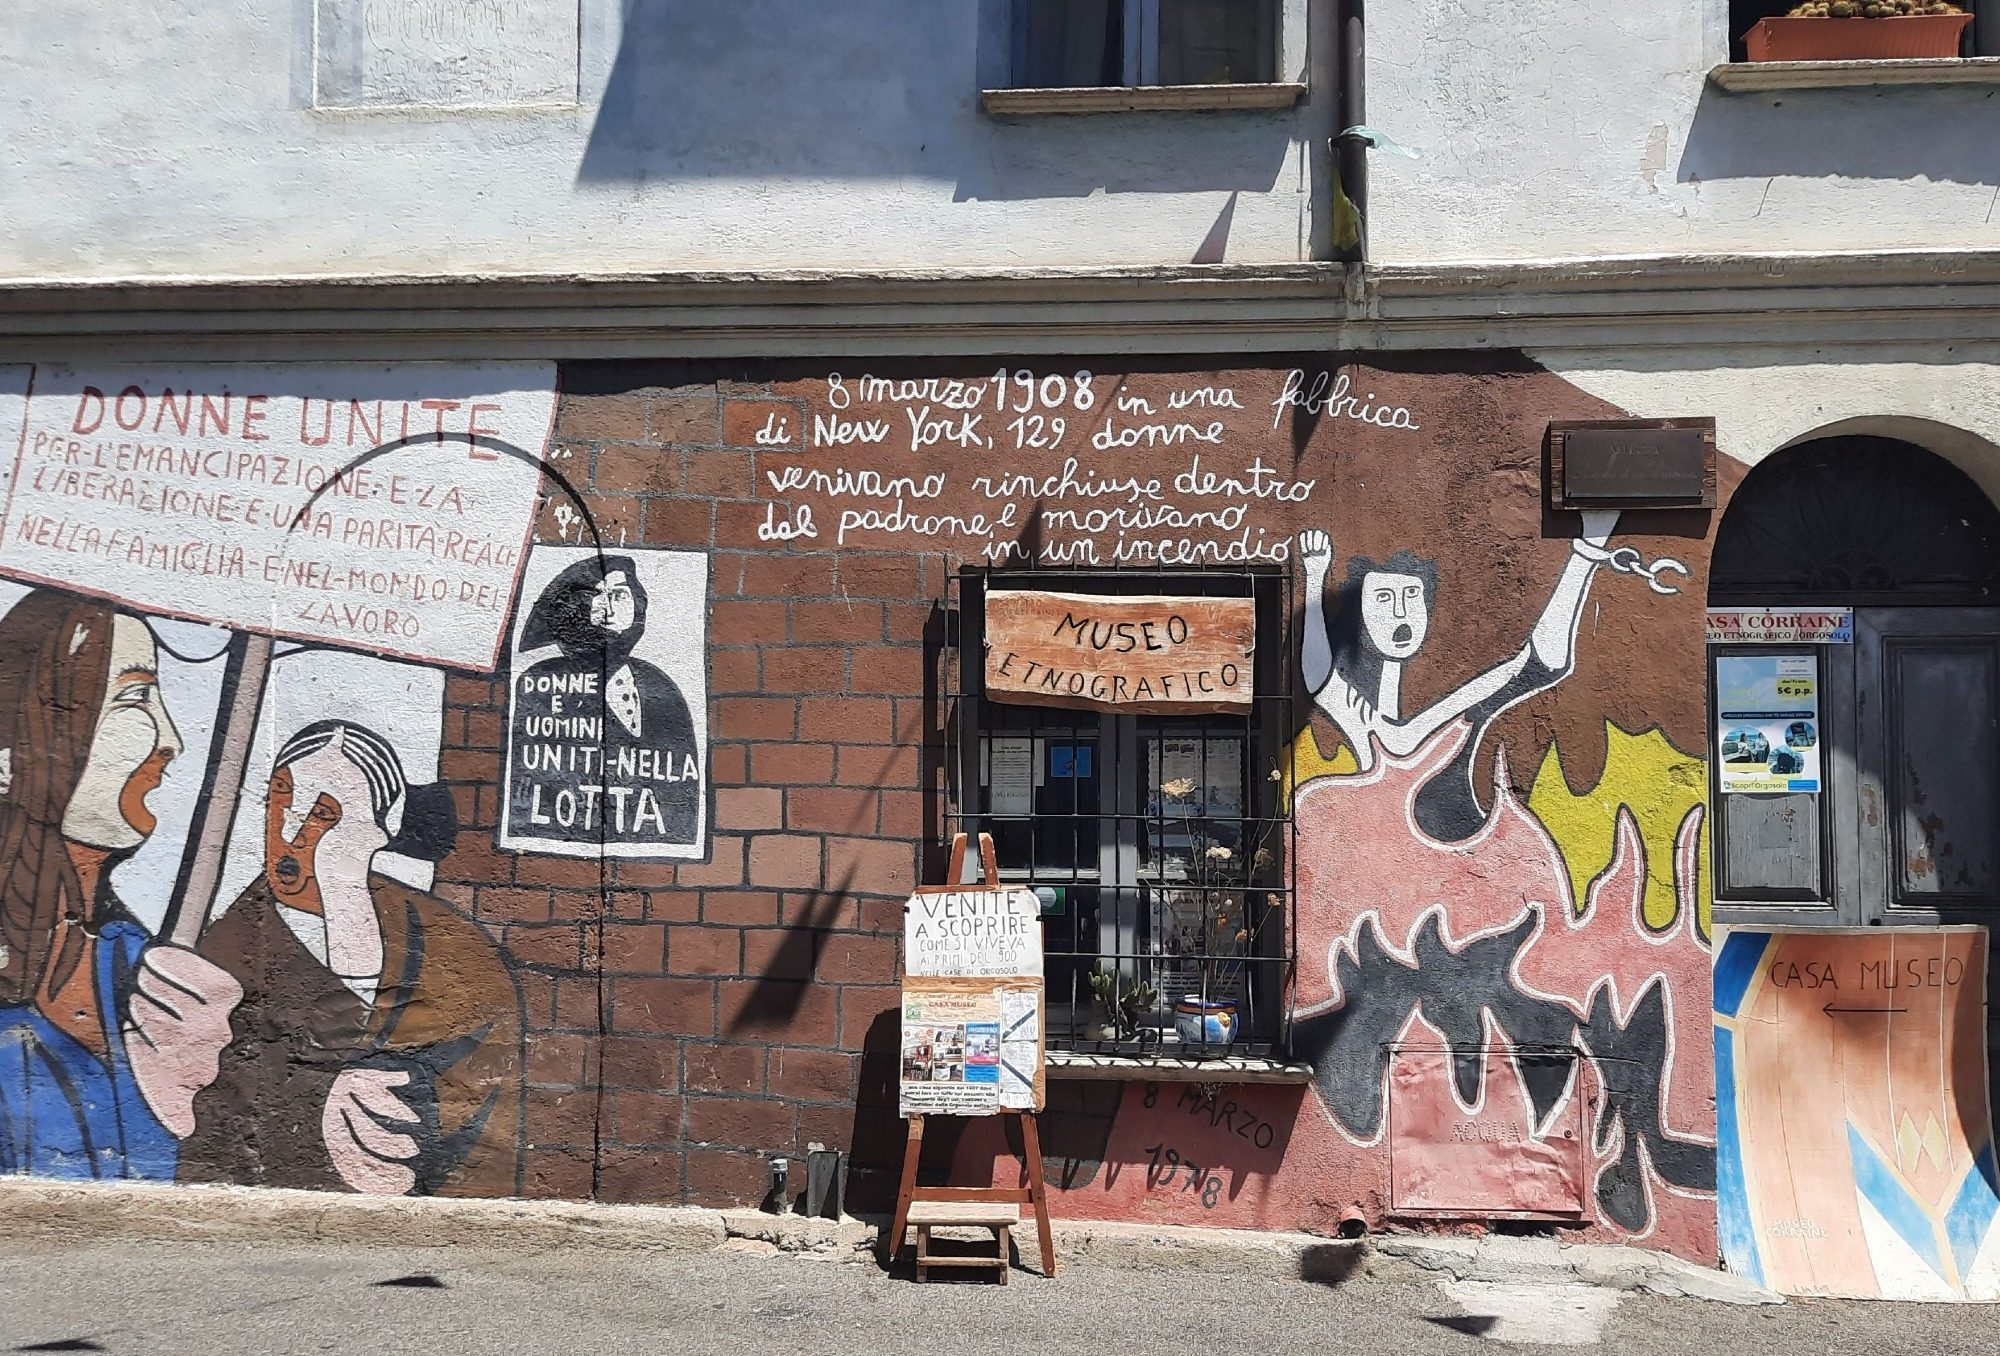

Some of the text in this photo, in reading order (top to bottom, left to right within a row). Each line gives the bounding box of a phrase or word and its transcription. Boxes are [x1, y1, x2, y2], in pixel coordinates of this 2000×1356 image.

[828, 367, 1420, 430] 8 marzo 1908 in una fabbrica
[72, 385, 502, 461] DONNE UNITE
[755, 413, 790, 445] di
[814, 413, 890, 447] New
[1006, 415, 1066, 450] 129
[1091, 418, 1224, 450] donne
[767, 454, 1316, 503] venivano rinchiuse dentro
[757, 502, 818, 541] dal
[997, 502, 1017, 528] e
[1041, 502, 1248, 532] morivano
[980, 526, 1293, 564] in un incendio
[1053, 612, 1188, 652] MUSEO
[1706, 616, 1849, 628] ASA CORRAINE
[1724, 631, 1791, 640] ETNOGRAFICO
[1799, 631, 1850, 640] ORGOSOLO
[524, 673, 598, 694] DONNE
[999, 652, 1238, 702] ETNOGRAFICO
[526, 716, 603, 742] UOMINI
[531, 784, 667, 834] LOTTA
[920, 891, 1020, 918] VENITE
[915, 916, 1029, 938] A SCOPRIRE
[975, 935, 1026, 950] VIVEVA
[935, 953, 964, 966] PRIMI
[970, 952, 990, 965] DEL
[944, 968, 962, 976] CASE
[979, 965, 1019, 976] ORGOSOLO
[1771, 957, 1965, 990] CASA MUSEO
[1143, 1082, 1274, 1149] 8 MARZO
[1450, 1119, 1522, 1144] ACQUA
[1144, 1142, 1224, 1209] 1978
